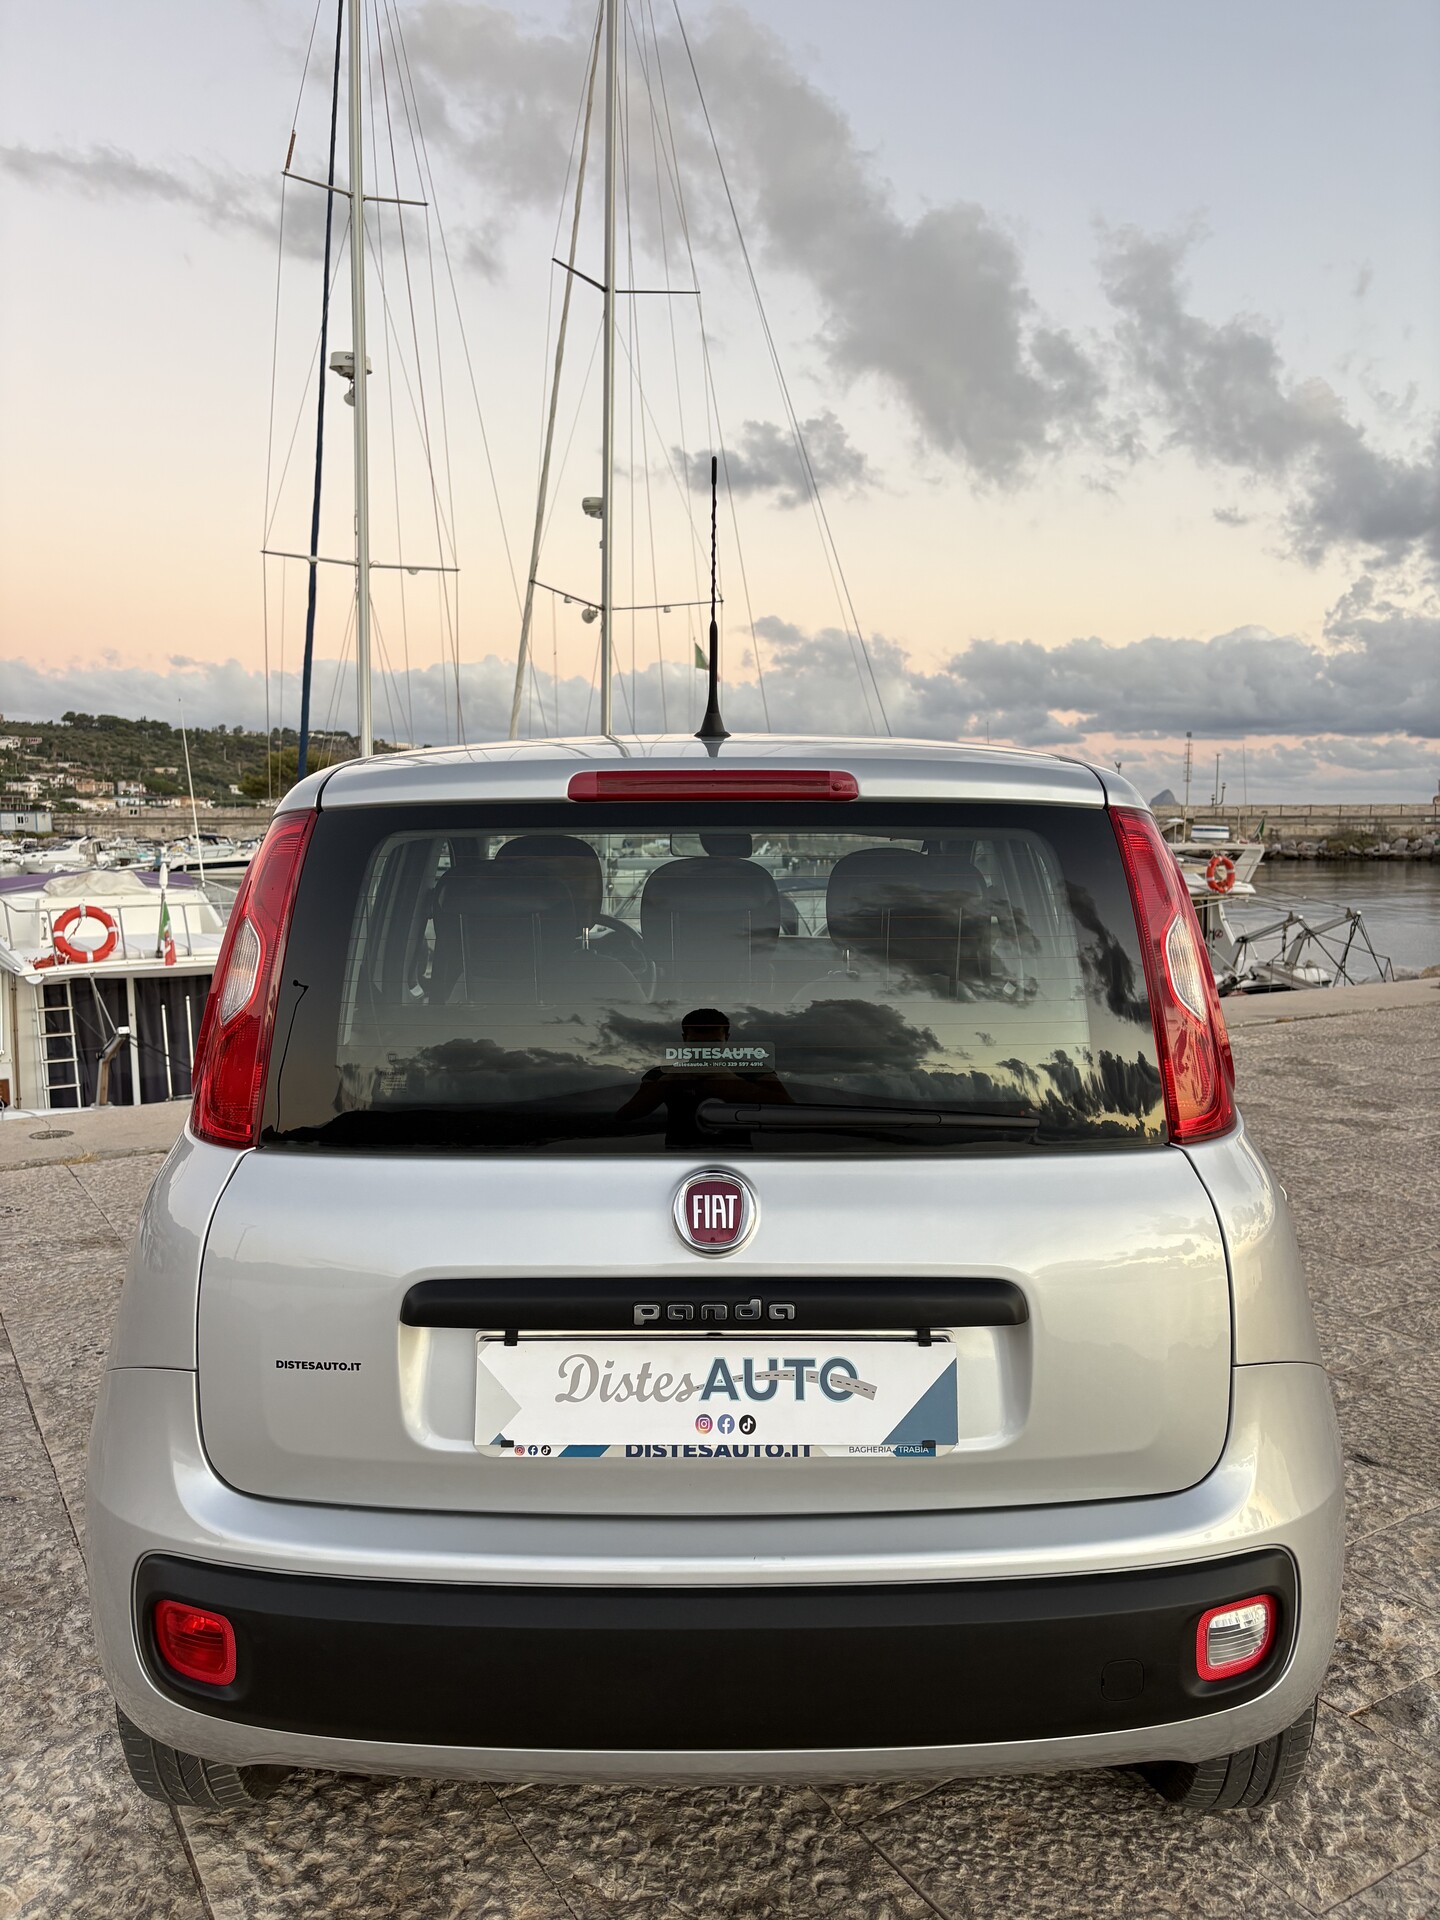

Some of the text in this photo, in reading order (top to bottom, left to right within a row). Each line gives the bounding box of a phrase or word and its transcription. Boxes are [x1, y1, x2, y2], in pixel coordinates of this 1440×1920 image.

[665, 1047, 769, 1060] DISTESAUTO
[692, 1194, 738, 1229] FIAT
[633, 1298, 796, 1326] panda
[275, 1360, 362, 1371] DISTESAUTO.IT
[625, 1444, 814, 1458] DISTESAUTO.IT
